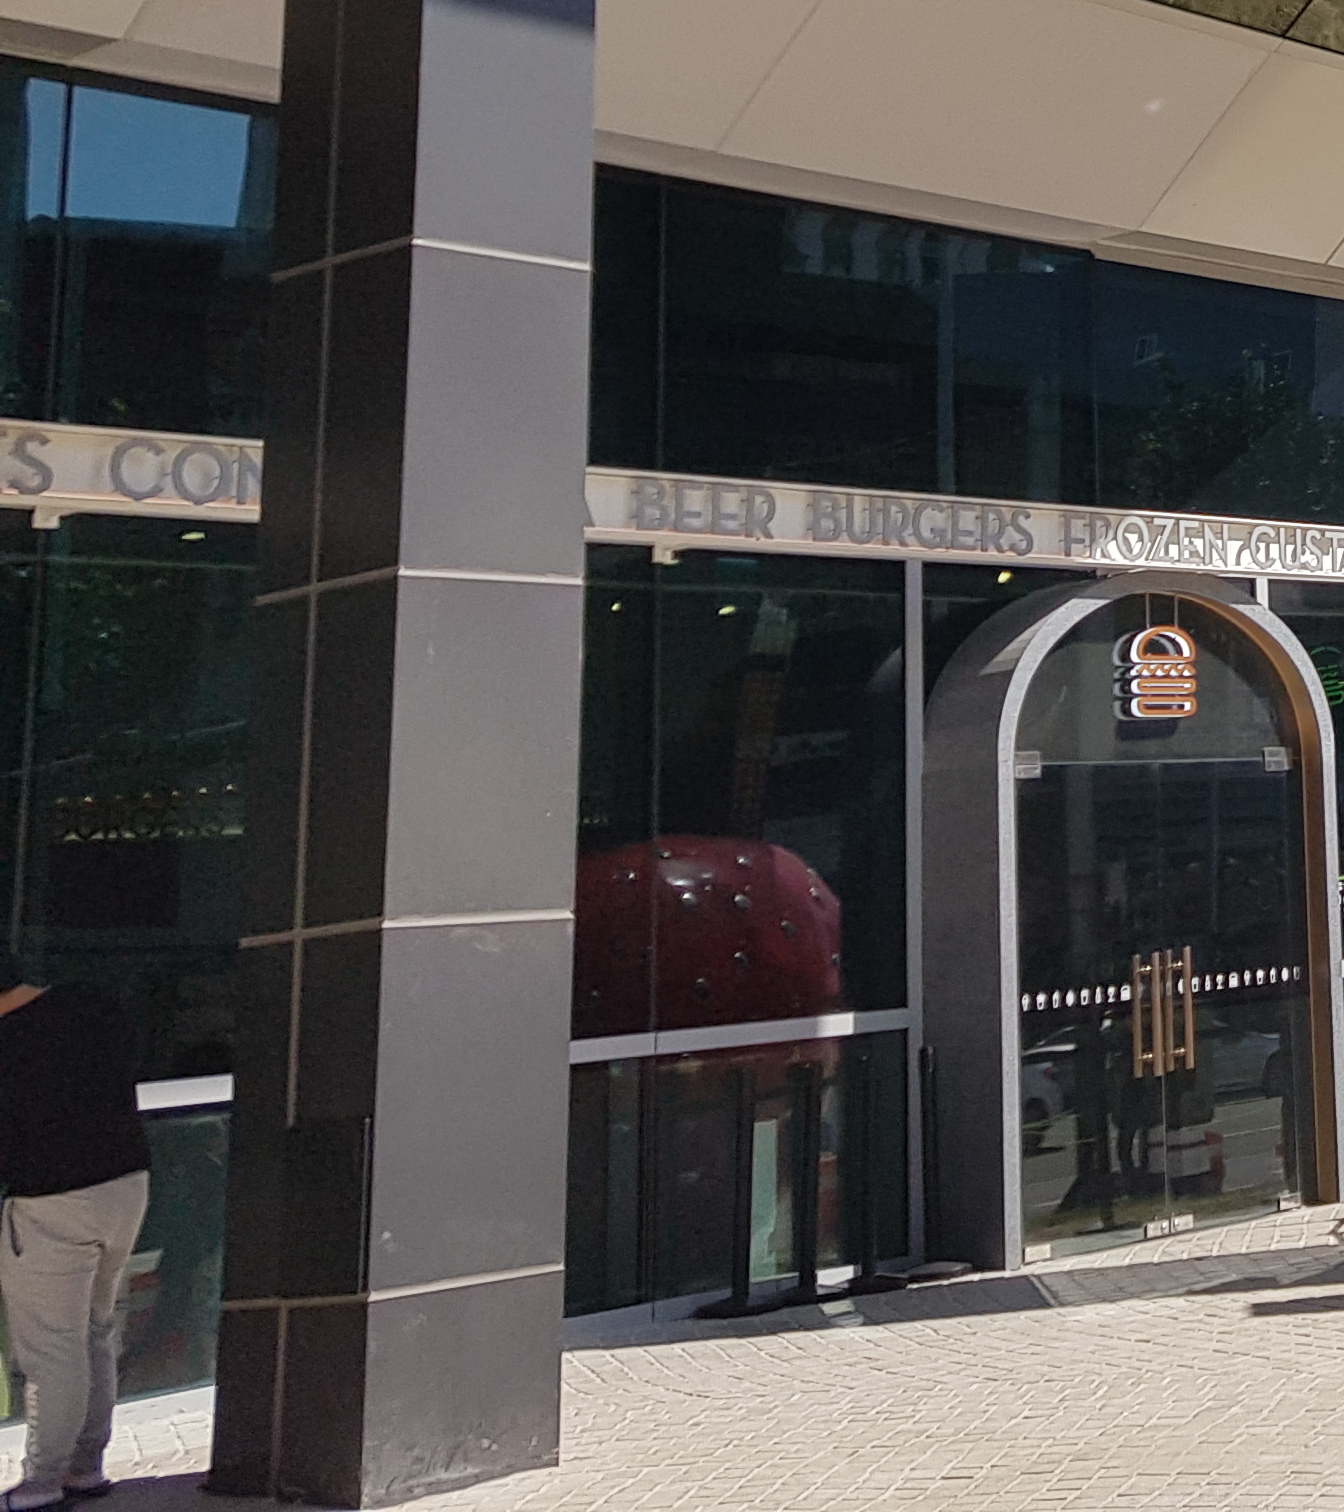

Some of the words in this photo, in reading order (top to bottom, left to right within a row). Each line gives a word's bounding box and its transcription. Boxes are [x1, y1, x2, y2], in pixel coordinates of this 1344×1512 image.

[635, 478, 777, 540] BEER
[810, 490, 1035, 556] BURGERS
[1062, 512, 1229, 569] FROZEN
